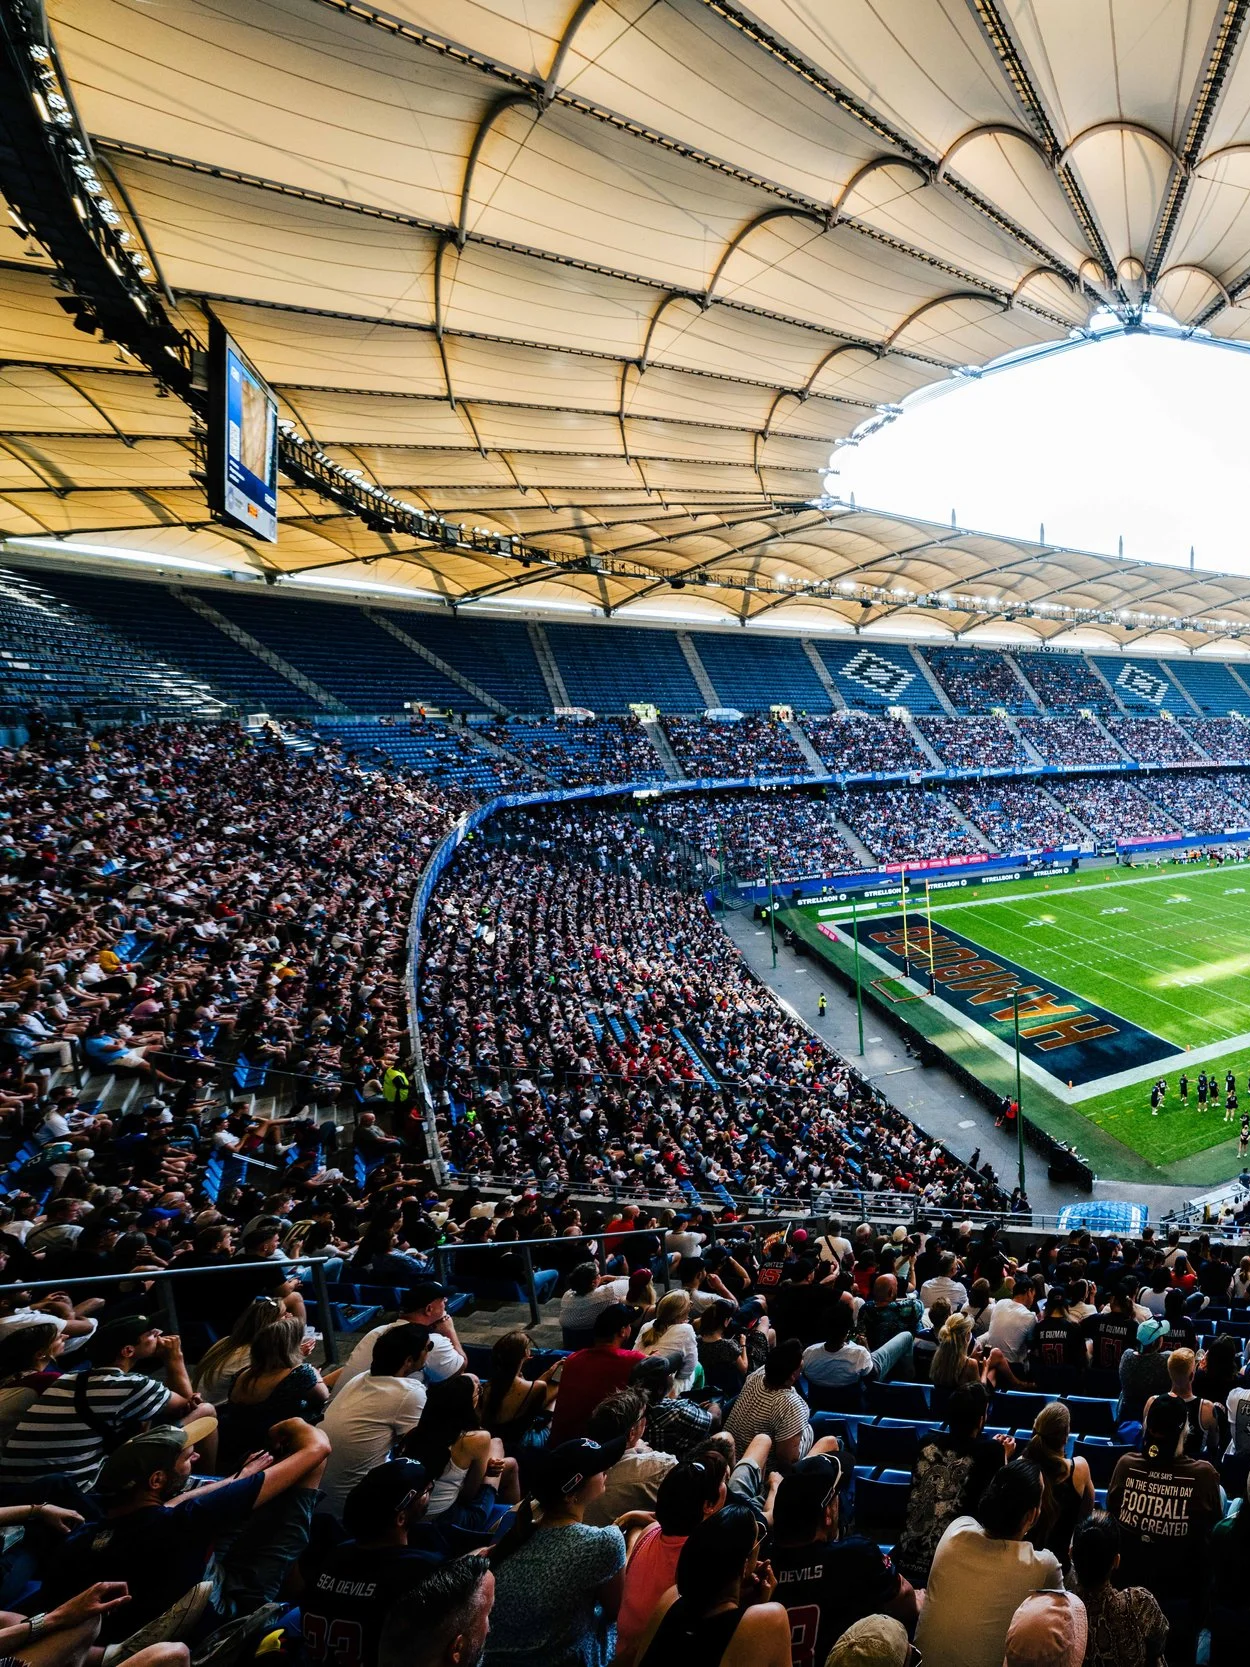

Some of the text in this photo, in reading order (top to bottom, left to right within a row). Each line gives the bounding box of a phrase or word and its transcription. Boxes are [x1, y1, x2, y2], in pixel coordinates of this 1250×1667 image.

[982, 874, 1013, 883] STRELLSON
[1033, 868, 1062, 877] STRELLSON
[797, 895, 838, 905] STRELLSON
[864, 887, 901, 898] STRELLSON
[868, 925, 1120, 1051] HAMBURG
[756, 1268, 783, 1287] 15
[1148, 1471, 1160, 1479] JACK
[1125, 1477, 1193, 1498] ON THE SEVENTH DAY
[1120, 1489, 1189, 1519] FOOTBALL
[1119, 1508, 1188, 1536] WAS CREATED
[779, 1564, 824, 1584] DEVILS
[316, 1573, 377, 1597] SEA DEVILS
